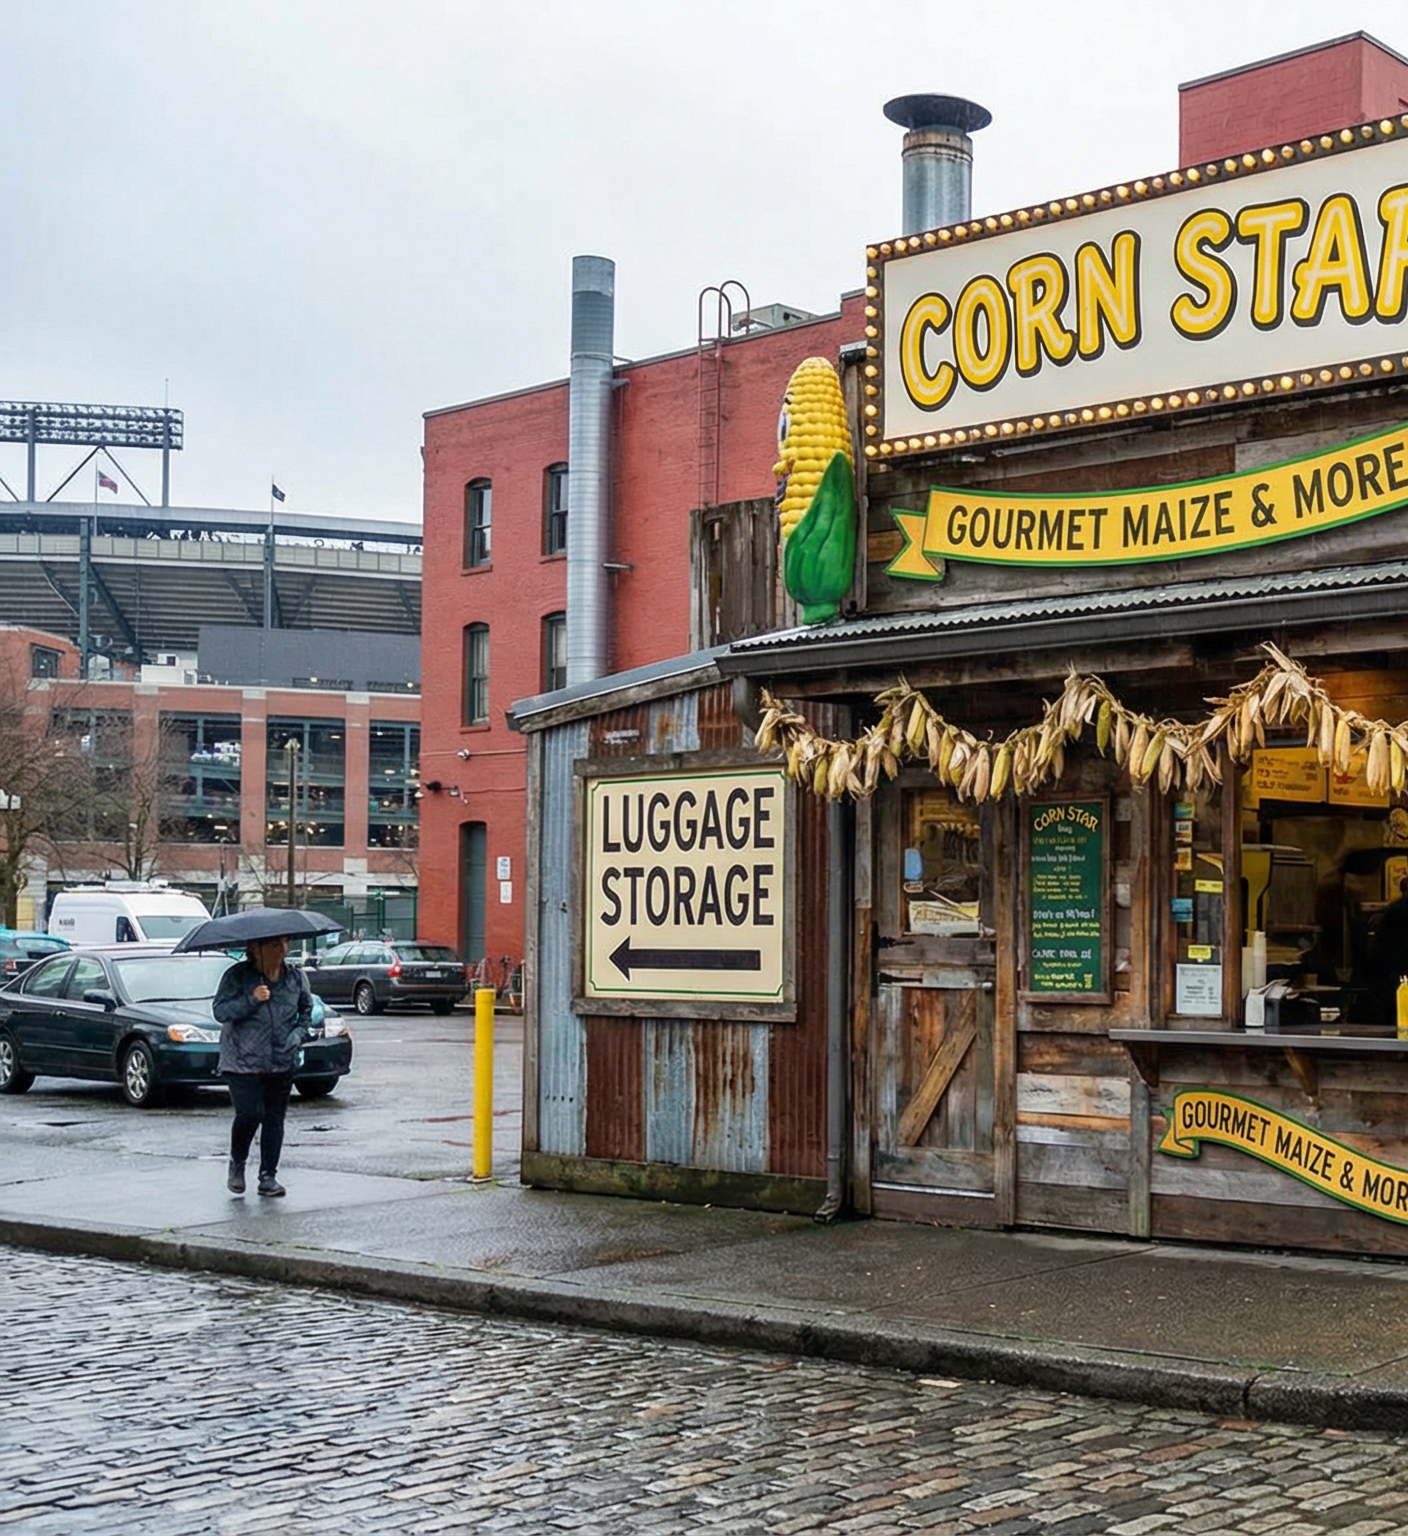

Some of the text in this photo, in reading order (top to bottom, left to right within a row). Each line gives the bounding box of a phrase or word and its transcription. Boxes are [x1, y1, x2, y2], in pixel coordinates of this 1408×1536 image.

[900, 230, 1142, 412] CORN
[947, 505, 1107, 551] GOURMET
[1123, 490, 1235, 548] MAIZE
[1251, 483, 1277, 528] &
[601, 785, 775, 853] LUGGAGE
[1034, 807, 1065, 831] CORN
[1067, 806, 1098, 832] STAR
[601, 864, 775, 927] STORAGE
[1182, 1100, 1271, 1147] GOURMET
[1274, 1126, 1336, 1182] MAIZE
[1340, 1160, 1354, 1192] &
